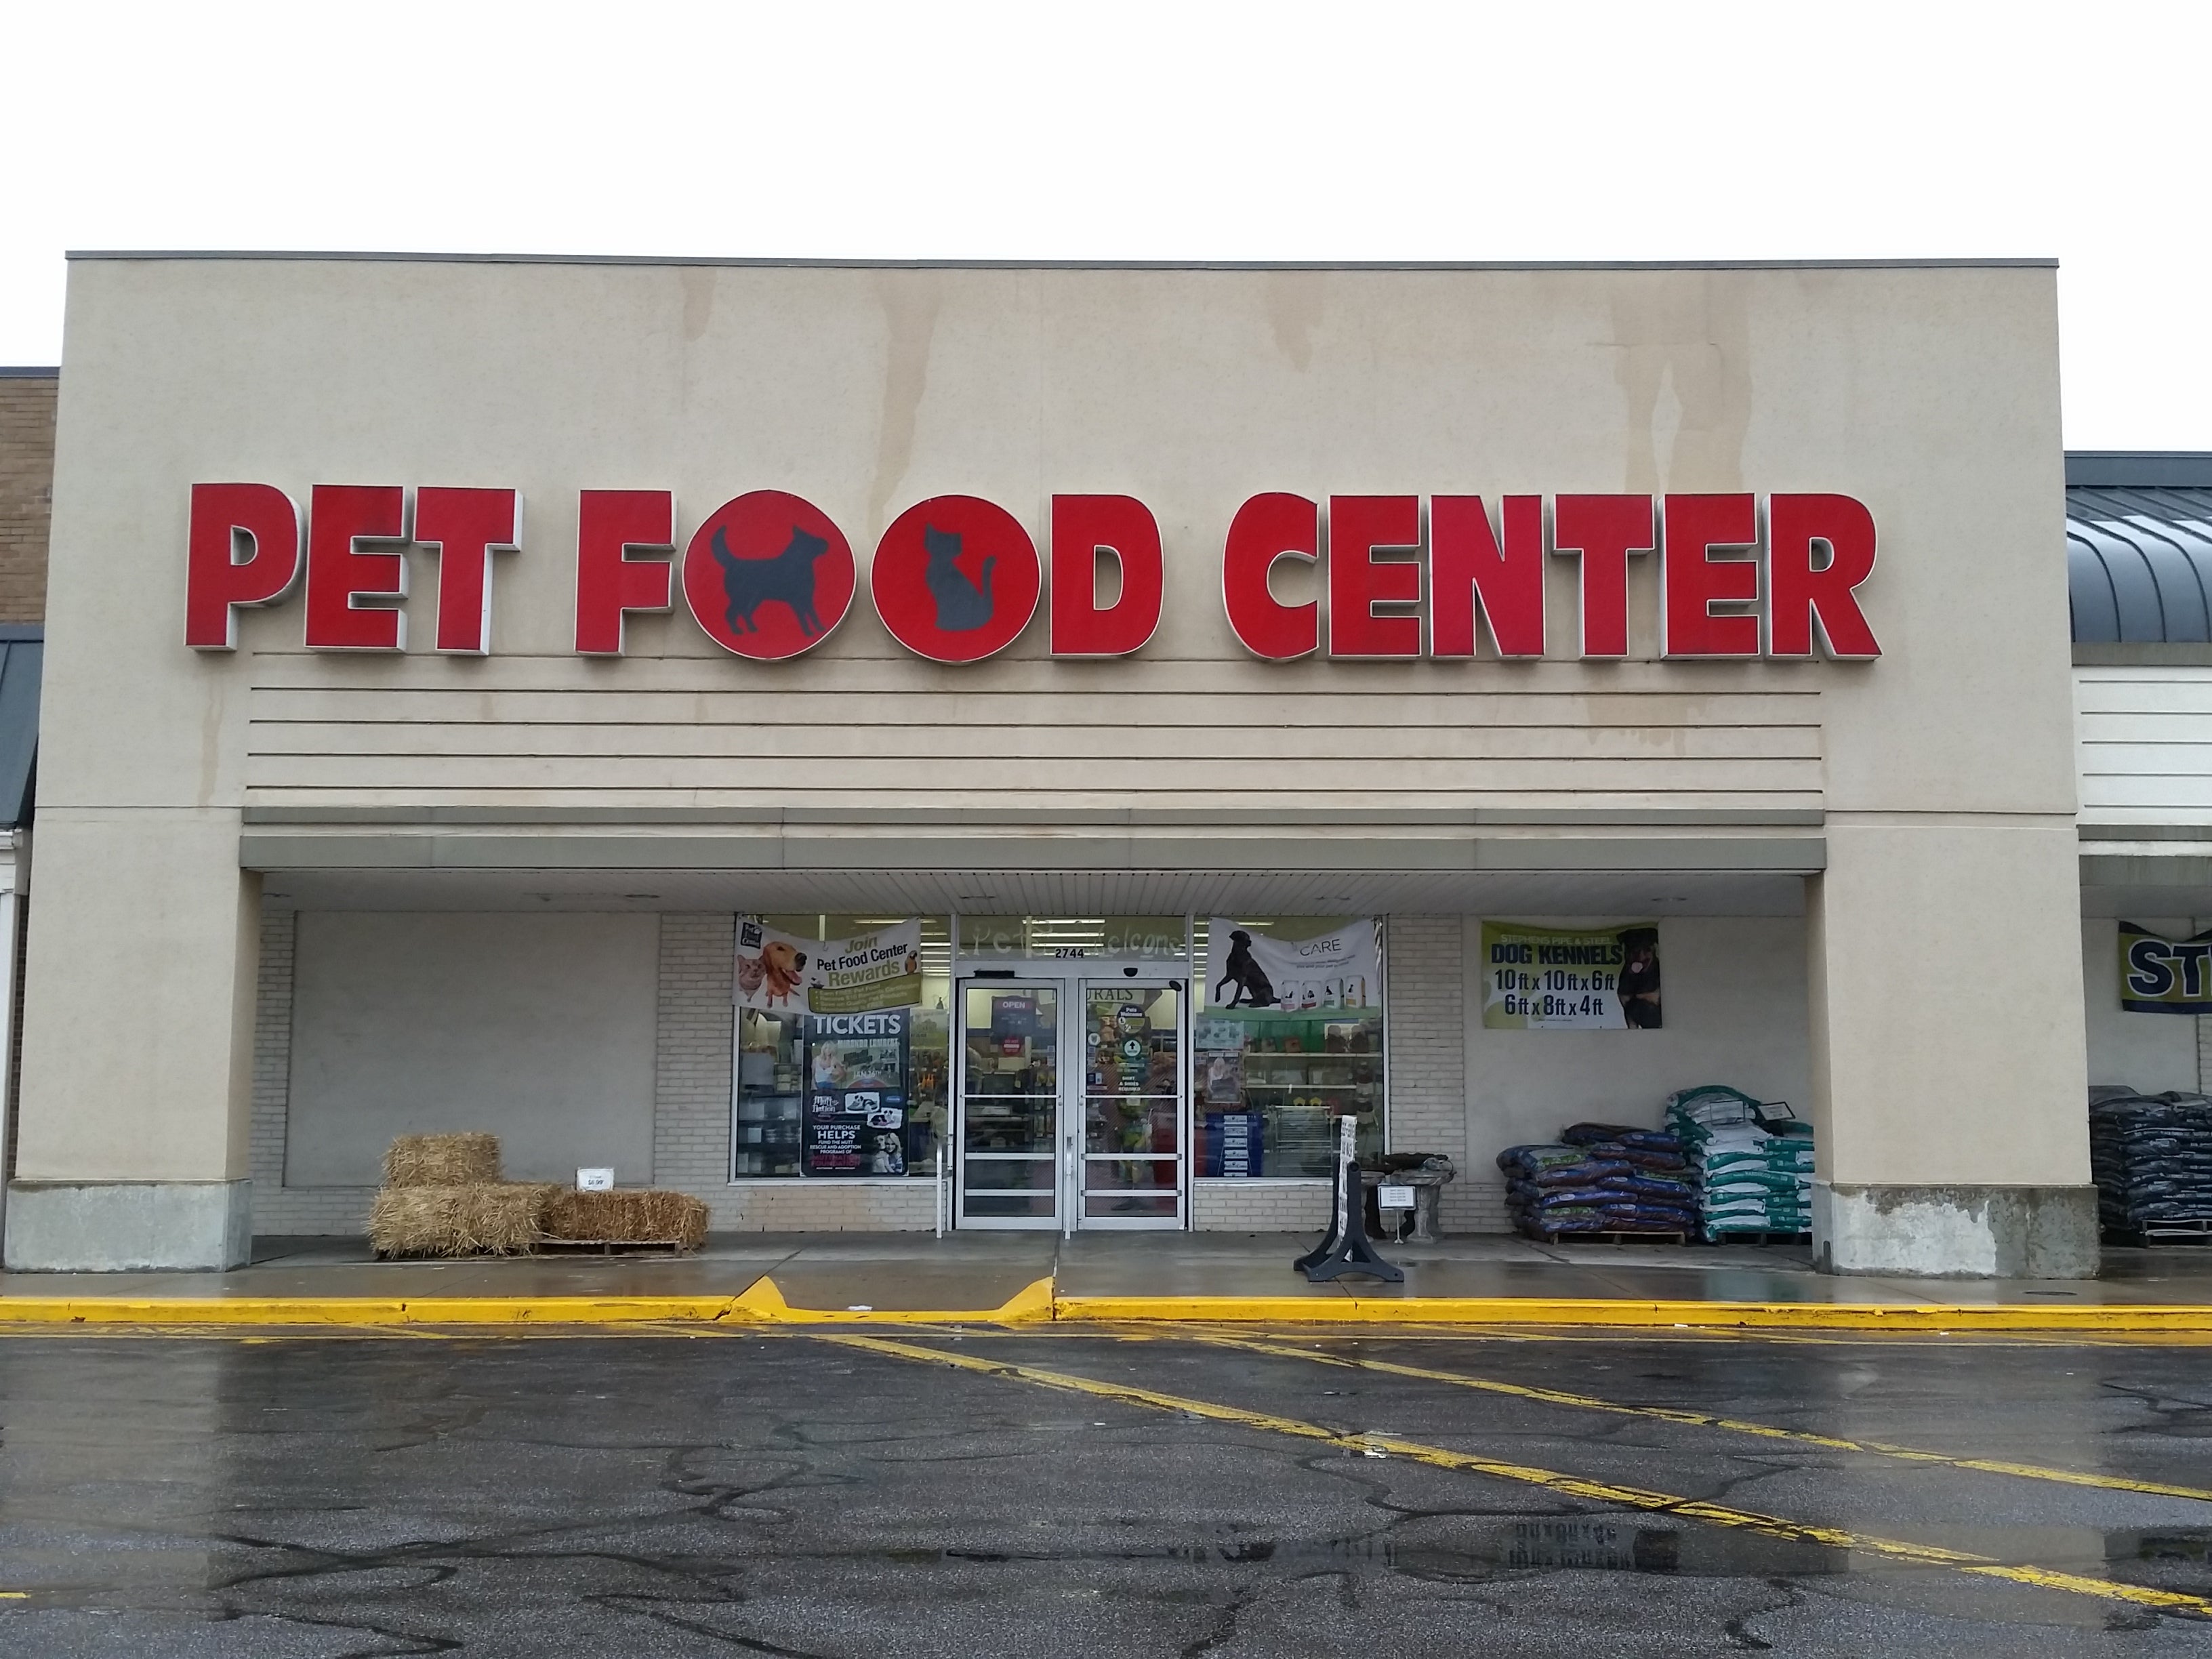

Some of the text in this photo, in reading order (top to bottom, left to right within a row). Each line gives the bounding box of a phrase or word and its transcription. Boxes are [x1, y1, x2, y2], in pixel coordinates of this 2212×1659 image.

[184, 483, 1883, 663] PET FOOD CENTER
[844, 936, 878, 954] Join
[1300, 939, 1342, 956] CARE
[1500, 934, 1551, 945] STEPHENS
[1551, 936, 1573, 945] PIPE
[1583, 936, 1613, 945] STEEL
[817, 943, 908, 971] Pet Food Center
[1054, 948, 1085, 959] 2744
[1491, 943, 1624, 965] DOG KENNELS
[828, 960, 900, 987] Rewards
[2127, 938, 2212, 998] ST
[813, 1014, 901, 1035] TICKETS
[812, 1104, 836, 1113] Nation
[813, 1095, 832, 1107] Mutt
[817, 1130, 856, 1140] HELPS
